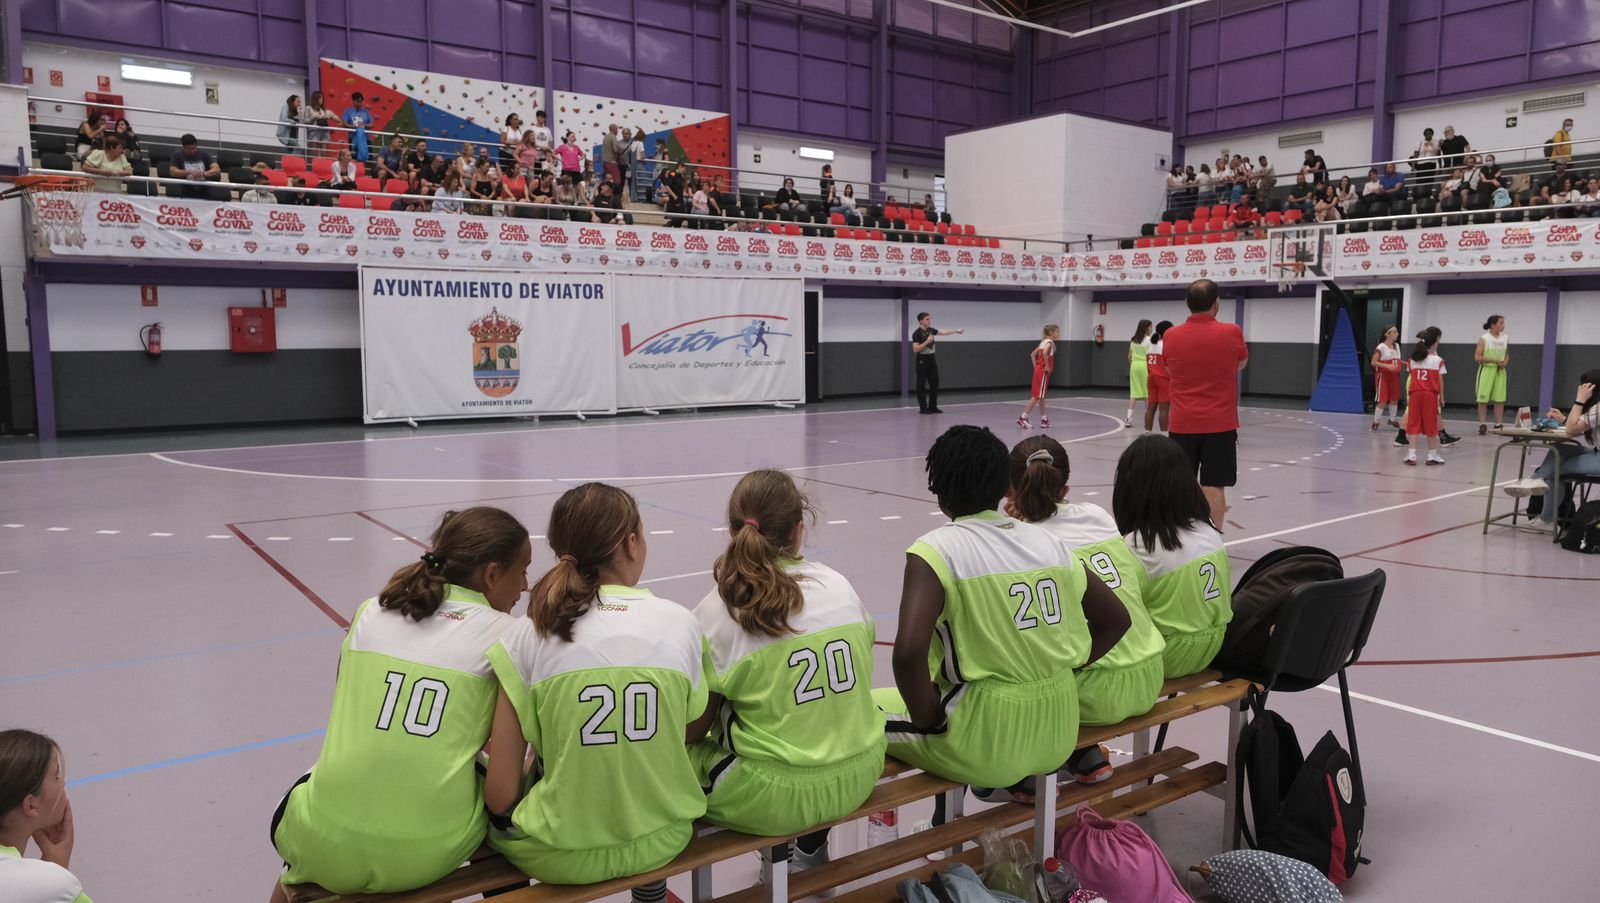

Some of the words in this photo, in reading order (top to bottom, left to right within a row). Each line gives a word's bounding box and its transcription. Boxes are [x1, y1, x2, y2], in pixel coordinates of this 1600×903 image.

[99, 200, 135, 213] COPA
[159, 205, 194, 217] COPA
[97, 211, 141, 224] COVAP
[216, 208, 248, 220] COPA
[270, 210, 300, 222] COPA
[320, 213, 350, 225] COPA
[156, 215, 199, 227] COVAP
[213, 218, 253, 230] COVAP
[267, 220, 305, 232] COVAP
[369, 216, 397, 227] COPA
[415, 218, 442, 229] COPA
[459, 220, 485, 231] COPA
[318, 222, 355, 234] COVAP
[367, 225, 401, 236] COVAP
[413, 227, 446, 239] COVAP
[501, 223, 525, 234] COPA
[541, 225, 565, 235] COPA
[580, 228, 602, 238] COPA
[1550, 225, 1577, 233] COPA
[457, 229, 489, 240] COVAP
[499, 232, 530, 242] COVAP
[539, 234, 569, 244] COVAP
[616, 230, 638, 239] COPA
[652, 232, 673, 241] COPA
[685, 234, 706, 243] COPA
[1382, 235, 1406, 244] COPA
[1421, 233, 1444, 241] COPA
[1462, 230, 1487, 239] COPA
[1501, 235, 1535, 245] COVAP
[1546, 232, 1582, 242] COVAP
[578, 236, 606, 246] COVAP
[615, 238, 642, 248] COVAP
[650, 240, 677, 249] COVAP
[684, 242, 709, 251] COVAP
[1345, 238, 1367, 246] COPA
[1418, 240, 1448, 249] COVAP
[1459, 238, 1490, 247] COVAP
[1343, 245, 1370, 254] COVAP
[1380, 243, 1408, 251] COVAP
[373, 279, 513, 299] AYUNTAMIENTO
[519, 282, 540, 299] DE
[545, 283, 604, 299] VIATOR
[621, 317, 750, 357] Viator
[629, 361, 676, 371] Concejalía
[693, 360, 733, 370] Deportes
[744, 358, 786, 369] Educación
[1417, 370, 1428, 380] 12
[1199, 562, 1220, 601] 2
[1008, 578, 1062, 631] 20
[788, 639, 857, 705] 20
[375, 671, 450, 738] 10
[578, 682, 659, 746] 20
